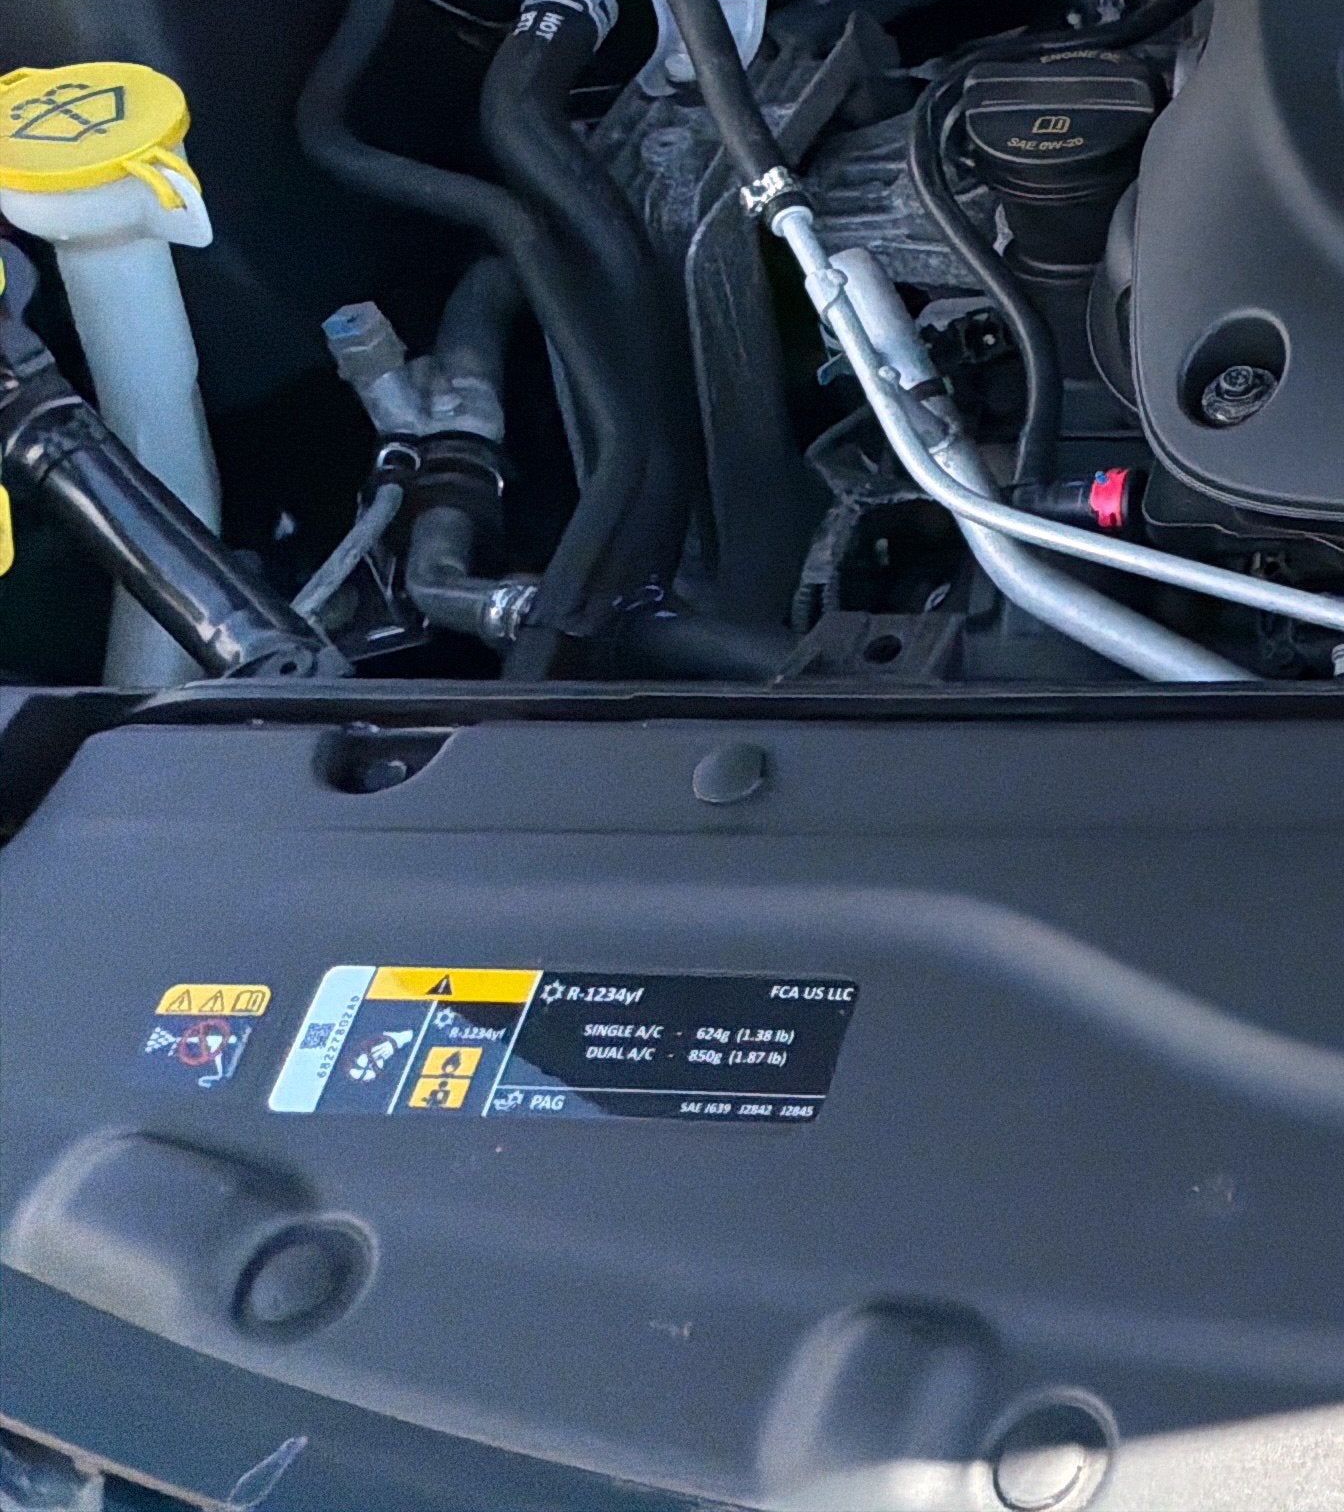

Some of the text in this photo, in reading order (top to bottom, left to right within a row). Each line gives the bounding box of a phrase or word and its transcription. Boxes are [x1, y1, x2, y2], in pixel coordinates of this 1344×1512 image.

[1007, 138, 1084, 150] SAE 0W-20
[567, 987, 645, 1005] R-1234yf
[770, 985, 855, 1001] FCA US LLC
[583, 1024, 634, 1038] SINGLE
[635, 1025, 664, 1039] A/C
[696, 1027, 731, 1044] 624g
[736, 1028, 772, 1044] (1.38
[774, 1029, 795, 1045] lb)
[586, 1047, 627, 1060] DUAL
[627, 1047, 656, 1060] A/C
[688, 1049, 723, 1065] 850g
[728, 1050, 765, 1065] (1.87
[767, 1051, 787, 1066] lb)
[530, 1095, 565, 1110] PAG
[679, 1101, 702, 1114] SAE
